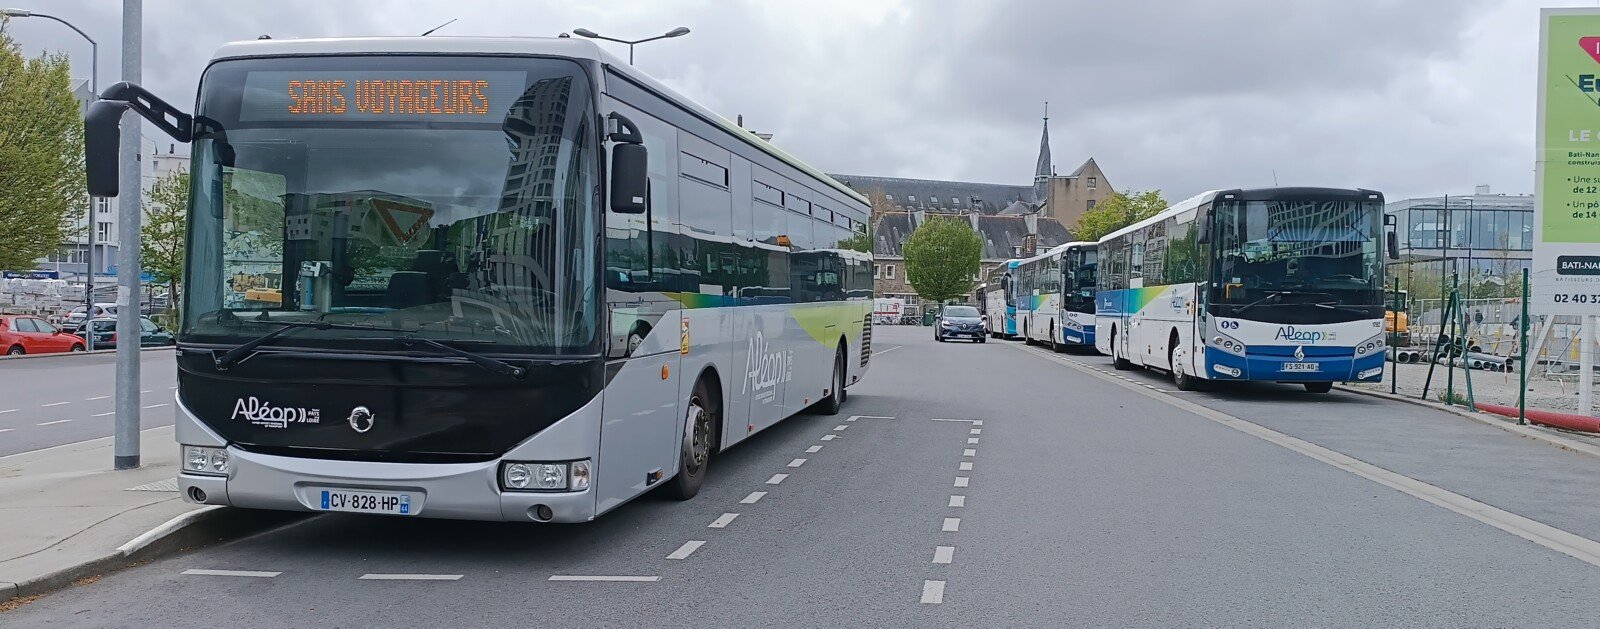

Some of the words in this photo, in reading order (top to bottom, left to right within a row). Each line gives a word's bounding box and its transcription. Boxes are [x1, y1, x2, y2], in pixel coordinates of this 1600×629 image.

[288, 79, 347, 114] SANS
[355, 79, 489, 114] VOYAGEURS
[1569, 129, 1591, 142] LE
[1572, 200, 1585, 208] Un
[1562, 261, 1600, 269] BATI-NA
[1554, 294, 1568, 303] 02
[1572, 294, 1587, 304] 40
[1275, 326, 1320, 344] Aléop
[742, 330, 782, 401] Aléop
[231, 396, 296, 428] Aléop
[331, 494, 399, 510] CV-828-HP
